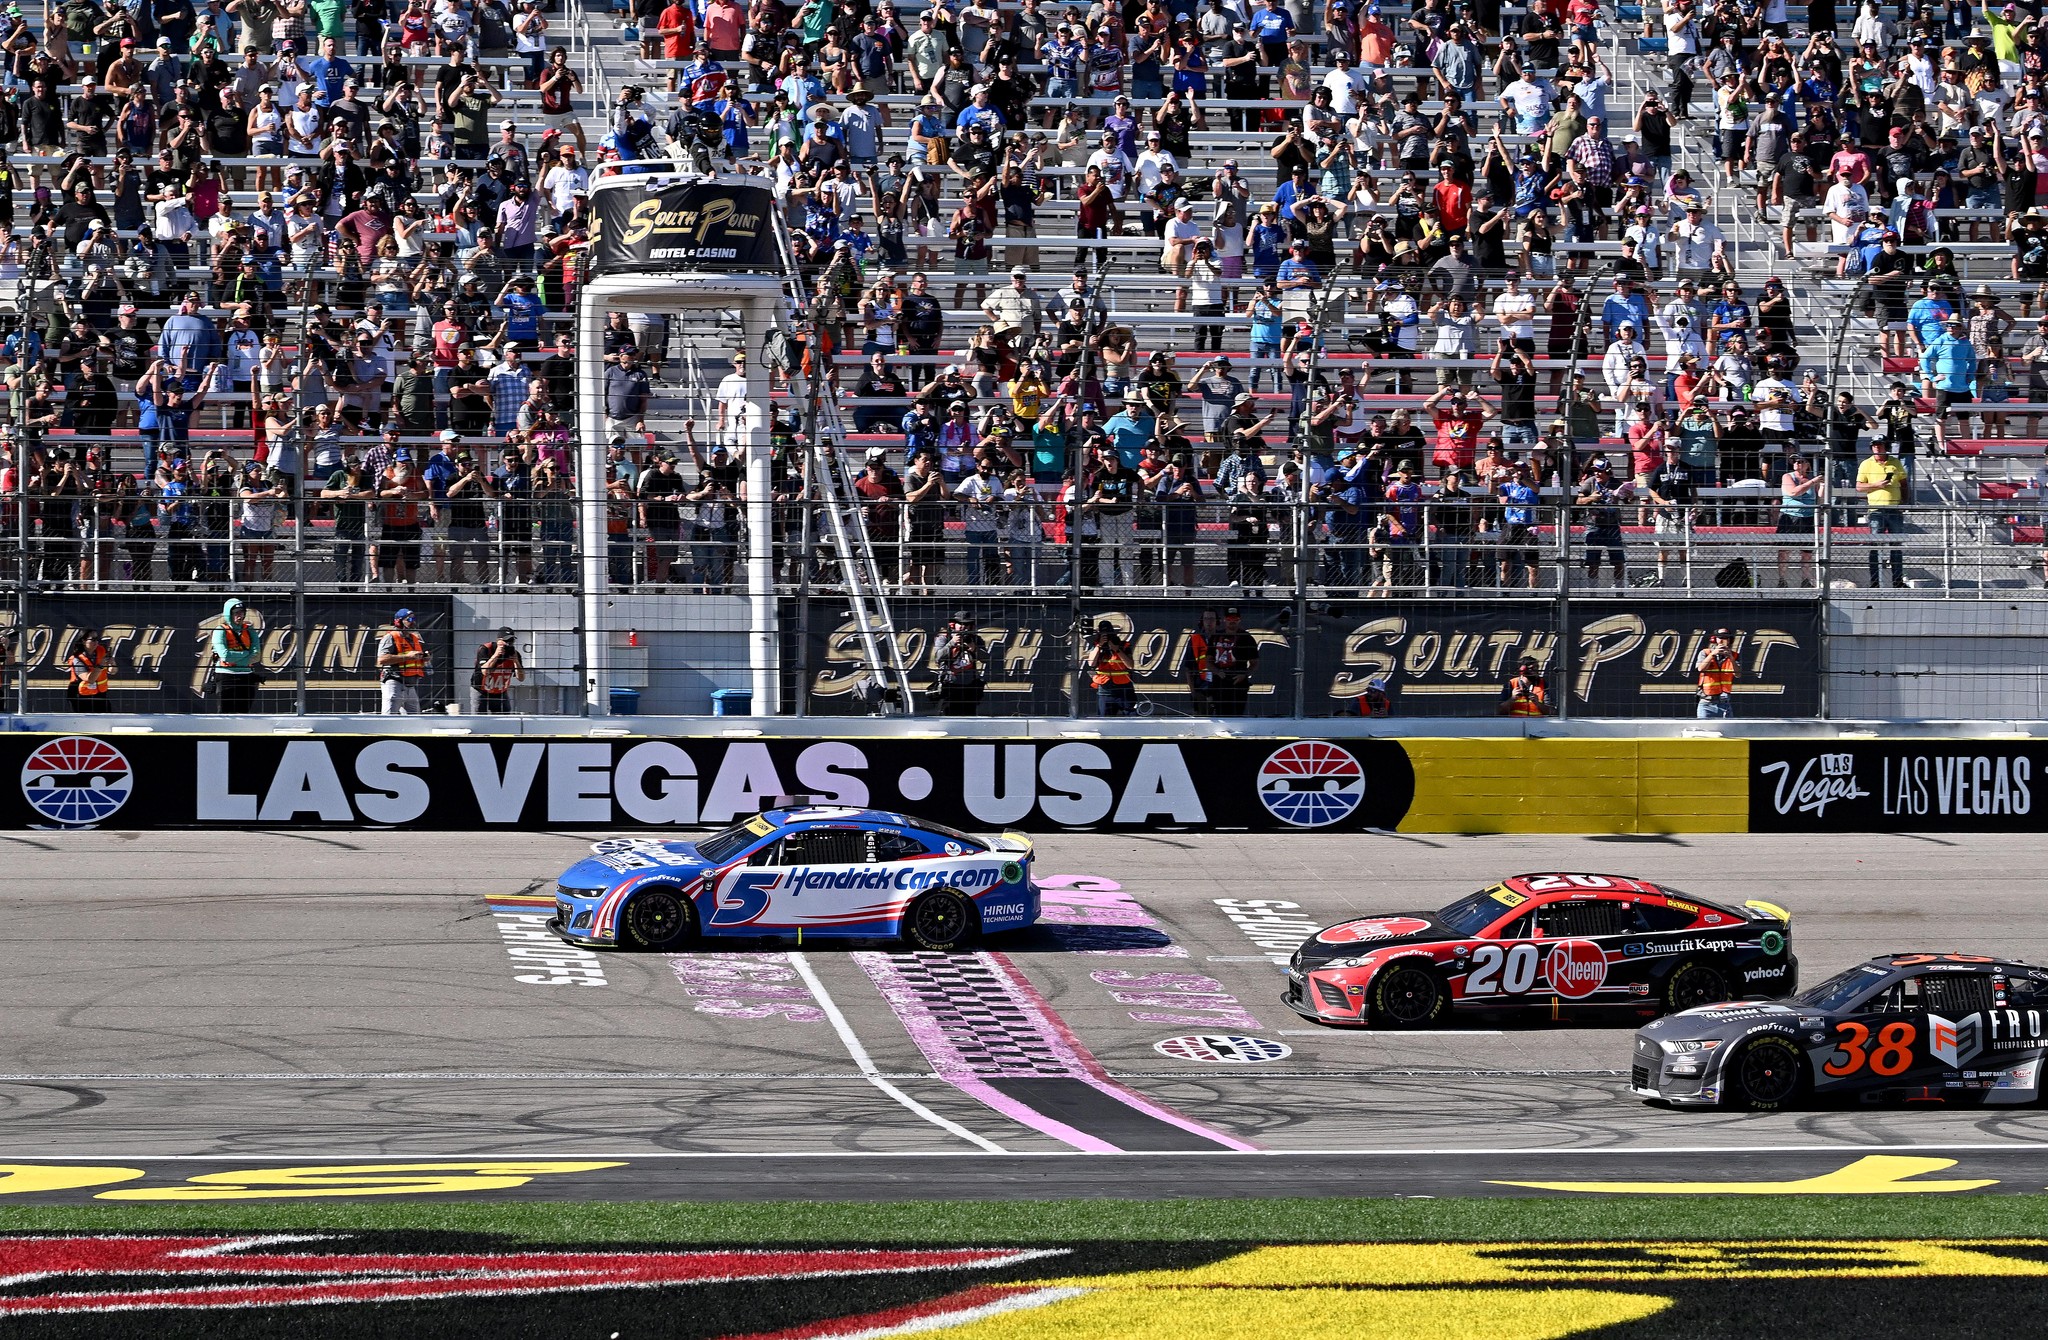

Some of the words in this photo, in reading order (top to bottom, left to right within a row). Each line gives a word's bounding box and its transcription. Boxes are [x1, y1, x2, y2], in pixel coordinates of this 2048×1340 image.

[326, 68, 337, 77] 21
[622, 198, 698, 246] SOUTH
[695, 197, 761, 244] POINT
[650, 248, 687, 259] HOTEL
[688, 249, 695, 257] &
[696, 248, 737, 259] CASINO
[810, 612, 1044, 697] SOTH
[1061, 611, 1291, 700] POIT
[1329, 616, 1560, 699] SOUTH
[1574, 613, 1800, 702] POIT
[1823, 755, 1852, 774] LAS
[197, 739, 430, 823] LAS
[458, 739, 870, 823] VEGAS
[963, 742, 1208, 825] USA
[1761, 757, 1870, 818] Vegas
[1883, 756, 1928, 815] LAS
[1935, 756, 2031, 815] VEGAS
[637, 873, 681, 886] GOODYEAR
[709, 871, 784, 928] 5
[983, 903, 1025, 917] HIRING
[983, 914, 1024, 924] TECHNICIANS
[1388, 948, 1434, 960] GOODYEAR
[1645, 939, 1694, 954] Smurfit
[1695, 938, 1735, 954] Kappa
[1463, 943, 1540, 995] 20
[1553, 941, 1603, 989] Rheem
[1744, 964, 1787, 982] yahoo!
[1376, 965, 1400, 1012] GOODYEAR
[1629, 984, 1649, 993] RUUD
[1668, 962, 1693, 1008] GOODYEAR
[1429, 994, 1444, 1020] EAGLE
[1746, 1022, 1795, 1036] GOODYEAR
[1748, 1036, 1799, 1055] GOODYEAR
[1823, 1021, 1917, 1076] 38
[1989, 1009, 2048, 1039] FRO
[1993, 1040, 2035, 1050] ENTERPRISES
